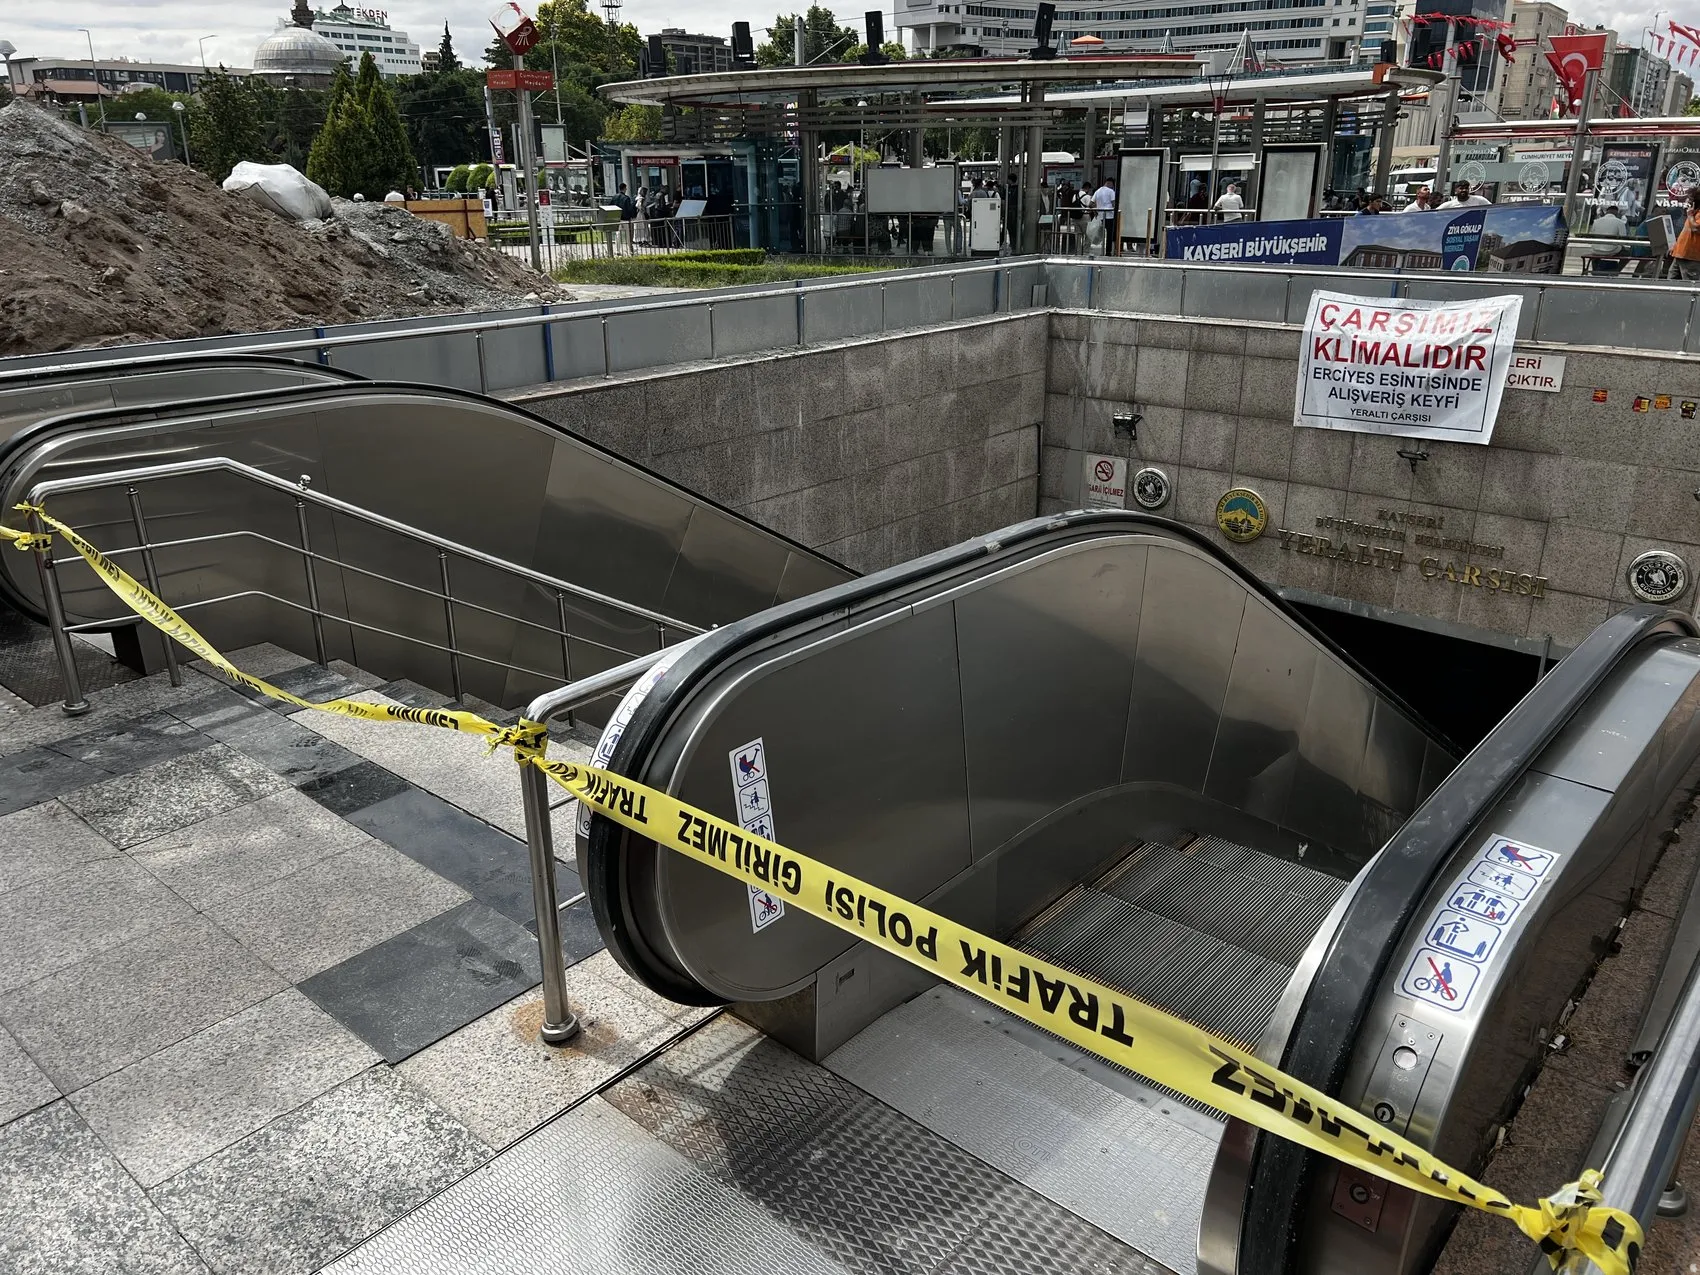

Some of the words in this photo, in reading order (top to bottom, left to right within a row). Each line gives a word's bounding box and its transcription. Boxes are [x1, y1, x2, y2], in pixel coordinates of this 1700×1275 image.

[350, 7, 388, 19] TEKDEN
[1521, 152, 1556, 160] CUMHURİYET
[1556, 151, 1574, 159] MEYD
[1460, 222, 1482, 234] GÖKALP
[1183, 238, 1243, 261] KAYSERİ
[1245, 233, 1328, 256] BÜYÜKŞEHİR
[1320, 304, 1494, 337] ÇARŞIMIZ
[1313, 334, 1487, 371] KLİMALIDIR
[1313, 367, 1375, 385] ERCİYES
[1379, 372, 1482, 392] ESİNTİSİNDE
[1505, 373, 1557, 388] ÇIKTIR.
[1328, 386, 1406, 409] ALIŞVERİŞ
[1410, 393, 1460, 409] KEYFİ
[1350, 408, 1389, 420] YERALTI
[1390, 411, 1431, 424] ÇARŞISI
[1377, 507, 1445, 530] KAYSERİ
[1277, 528, 1404, 573] YERALTI
[1418, 555, 1549, 600] ÇARŞISI
[1641, 561, 1677, 576] DESTEK
[576, 770, 649, 825] TRAFİK
[677, 810, 802, 896] GİRİLMEZ
[824, 880, 939, 962] POLİSİ
[959, 939, 1135, 1049] TRAFİK
